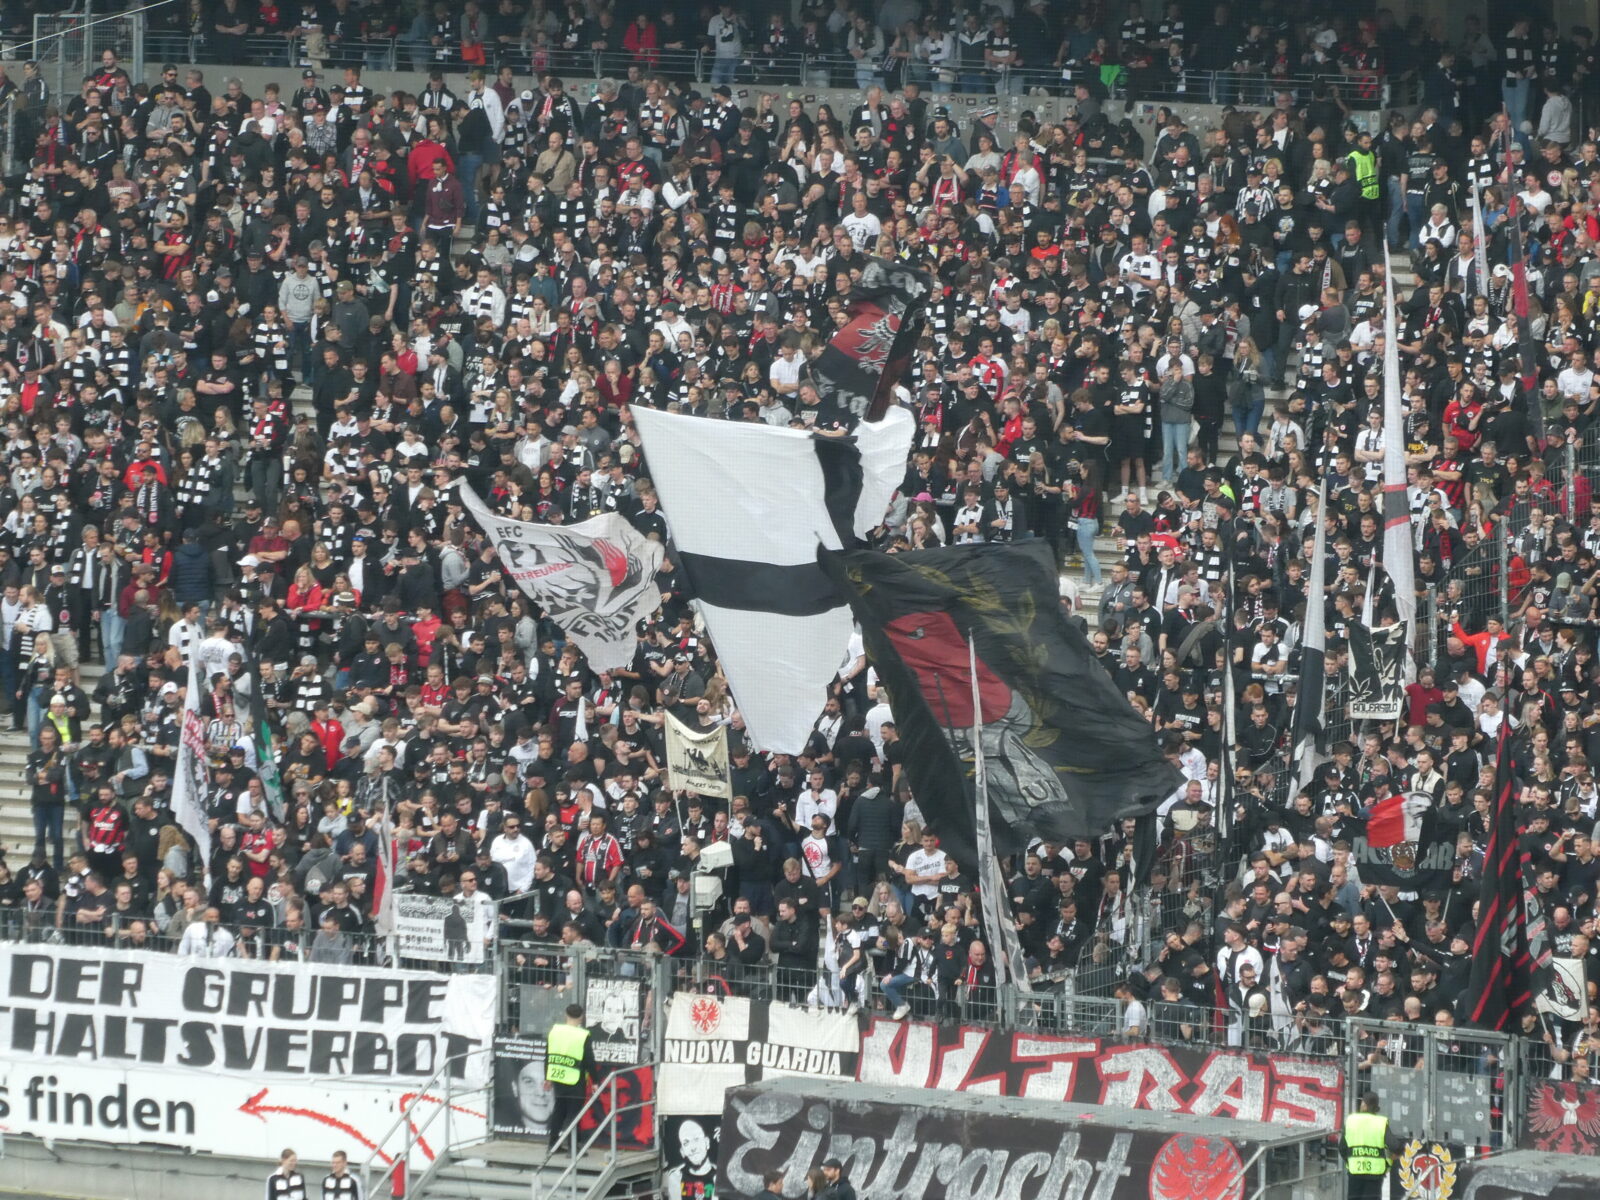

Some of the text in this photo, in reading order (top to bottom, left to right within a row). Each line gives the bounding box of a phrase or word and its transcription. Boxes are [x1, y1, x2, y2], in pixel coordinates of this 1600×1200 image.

[496, 526, 523, 538] EFC
[8, 953, 448, 1025] DER GRUPPE
[0, 1006, 482, 1080] HALTSVERBOT
[665, 1040, 842, 1076] NUOVA GUARDIA
[856, 1017, 1342, 1131] ULTRAS
[24, 1075, 196, 1135] finden
